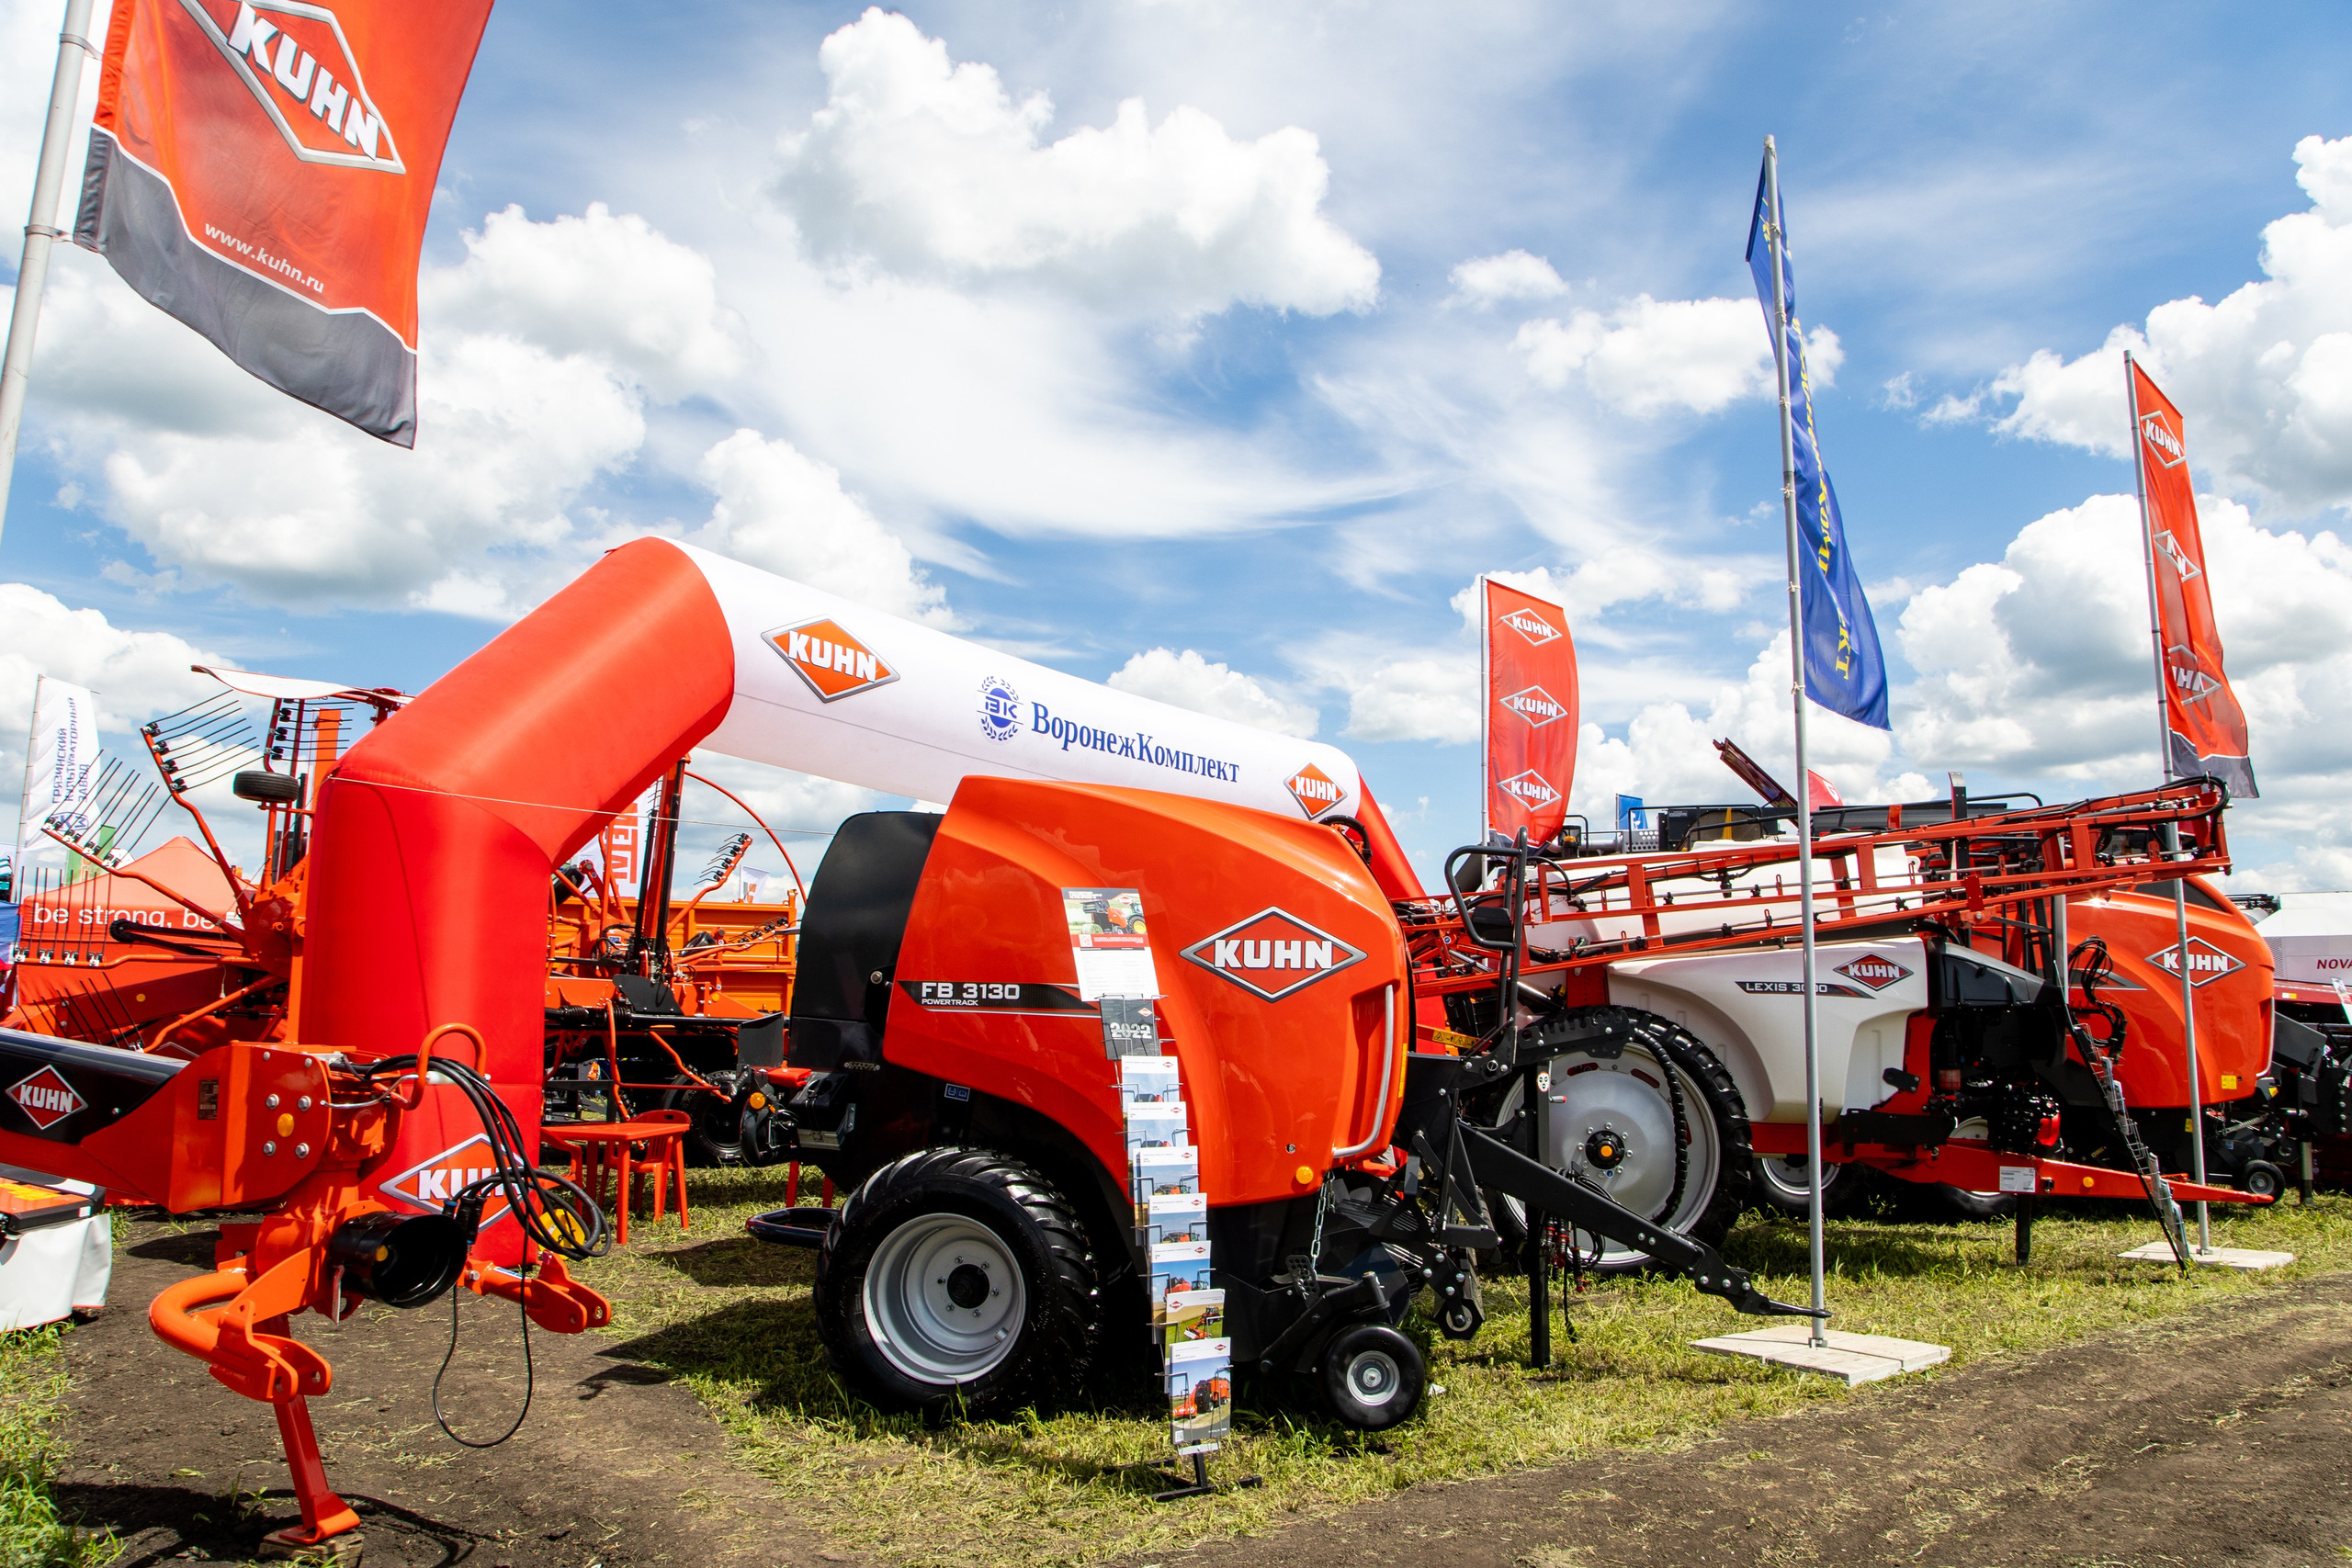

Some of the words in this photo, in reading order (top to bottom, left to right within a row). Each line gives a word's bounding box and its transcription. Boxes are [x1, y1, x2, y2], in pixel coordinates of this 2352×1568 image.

[227, 0, 379, 160] KUHN
[204, 221, 324, 294] www.kuhn.ru
[2145, 419, 2182, 457] KUHN
[1511, 615, 1553, 637] KUHN
[788, 630, 876, 682] KUHN
[1513, 696, 1558, 717] KUHN
[1031, 701, 1240, 783] ВоронежКомплект
[51, 728, 67, 804] ГРЯЗИНСКИЙ
[77, 763, 90, 803] ЗАВОД
[1295, 775, 1337, 802] KUHN
[1511, 780, 1551, 801] KUHN
[34, 902, 69, 924] be
[1214, 939, 1333, 969] KUHN
[1848, 964, 1900, 978] KUHN
[922, 982, 954, 998] FB
[963, 983, 1020, 1000] 3130
[1746, 982, 1788, 992] LEXIS
[1792, 983, 1827, 993] 30
[1110, 1021, 1153, 1039] 2022
[19, 1084, 74, 1113] KUHN
